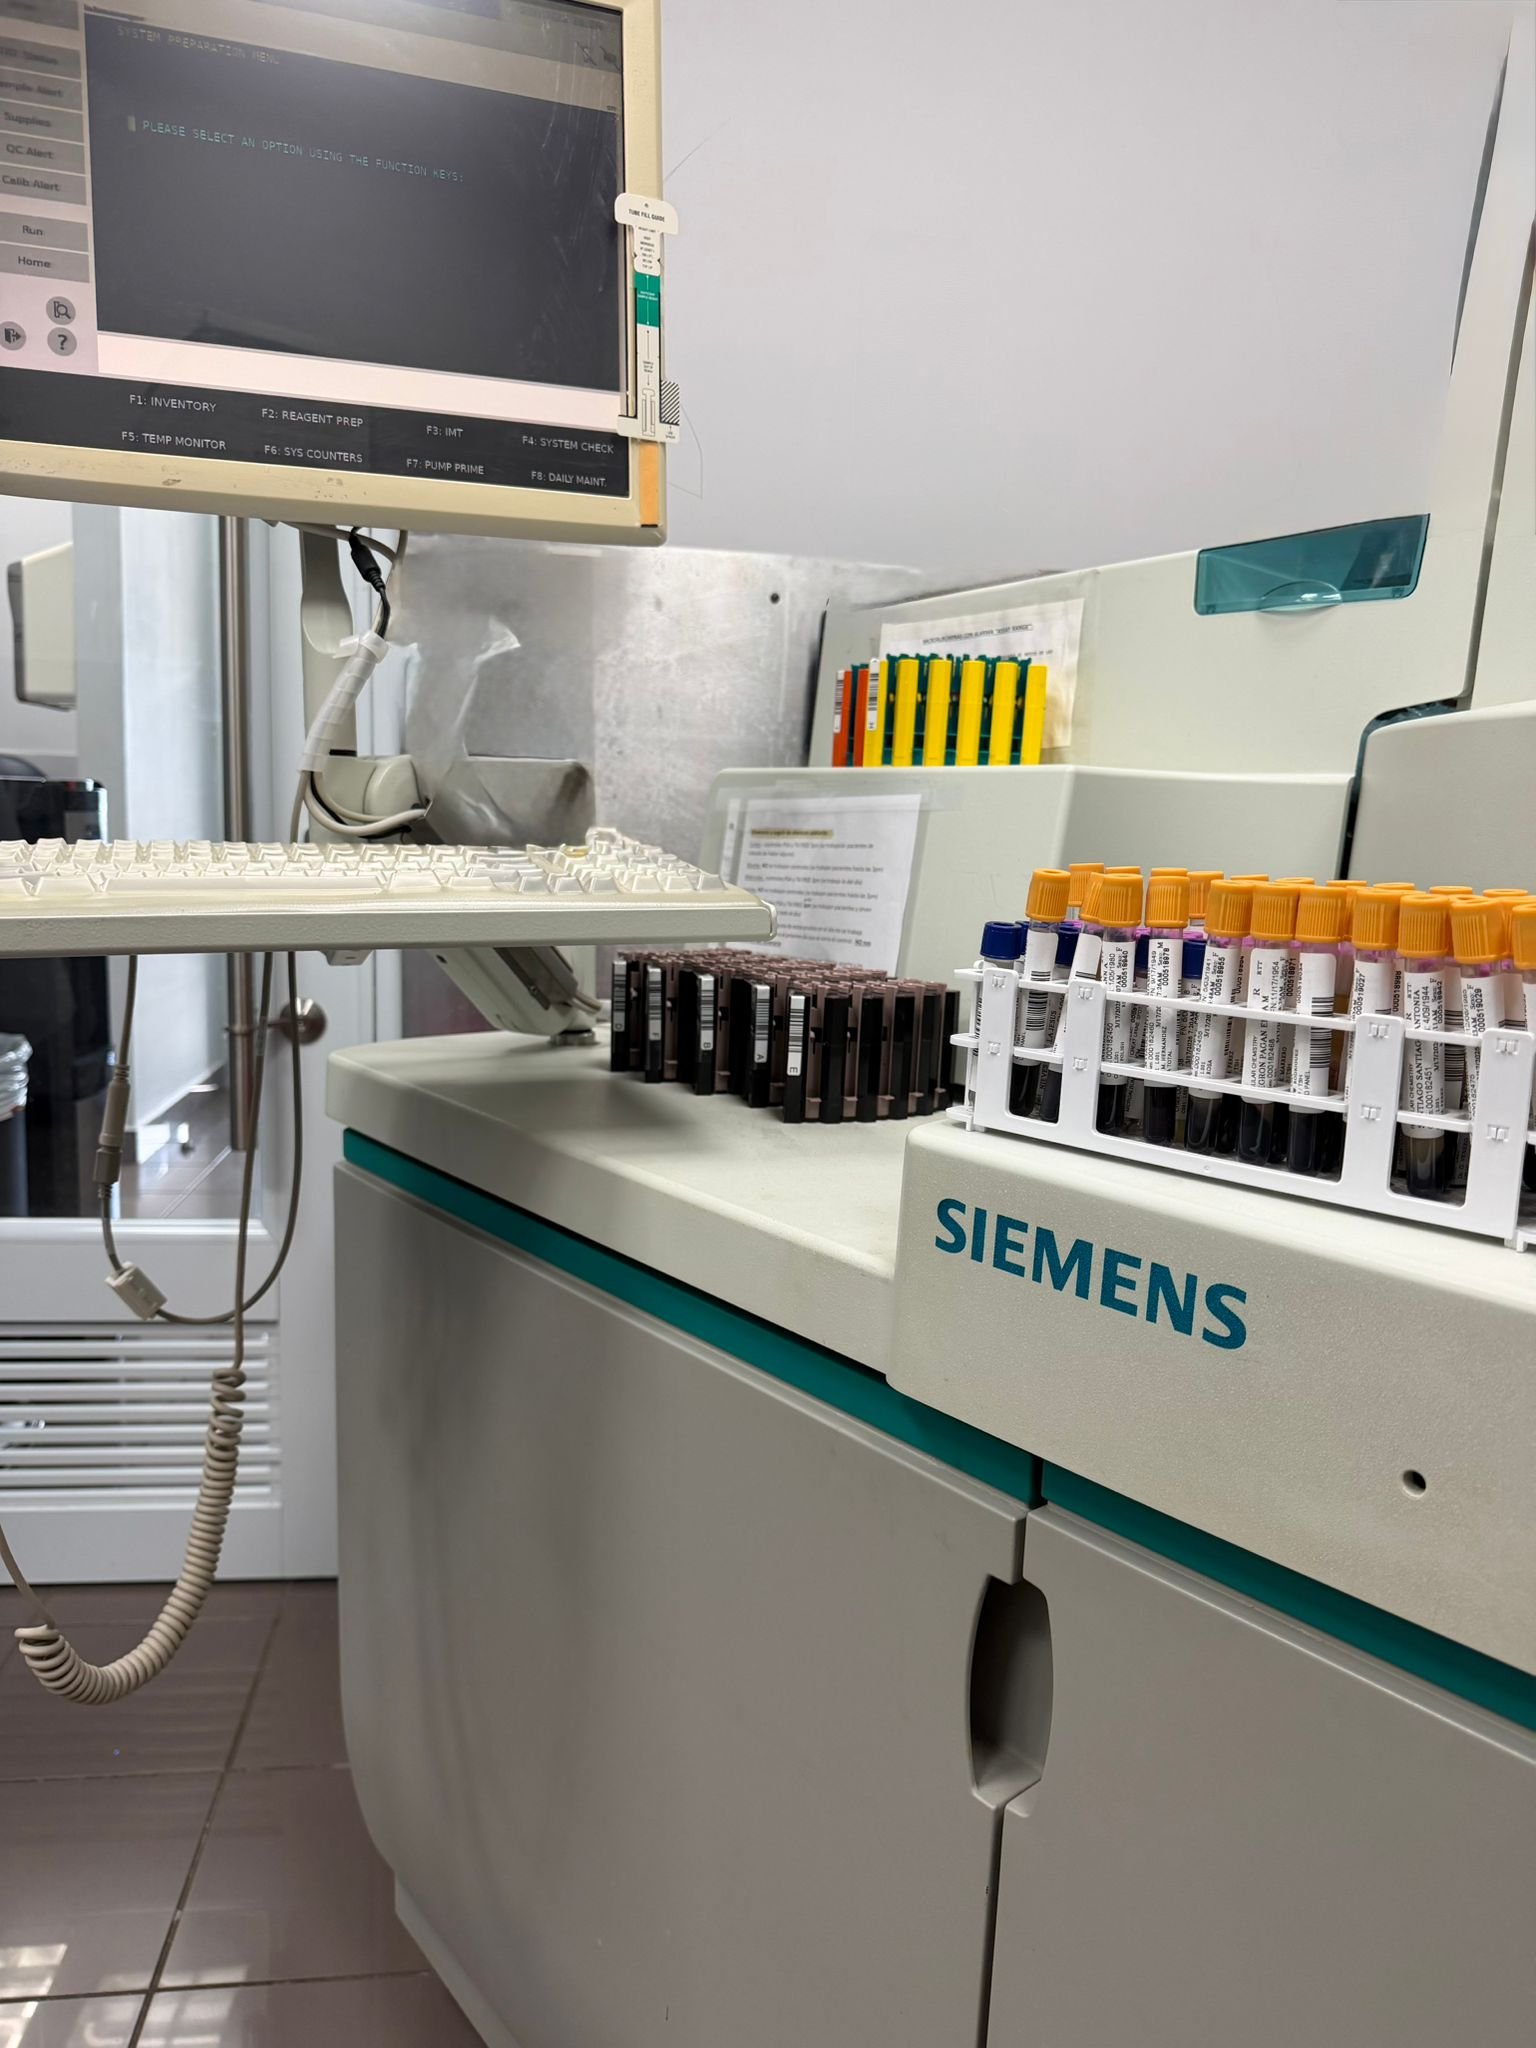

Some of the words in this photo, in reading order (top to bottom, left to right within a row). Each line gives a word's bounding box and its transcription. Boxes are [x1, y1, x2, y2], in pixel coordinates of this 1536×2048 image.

[116, 24, 161, 42] SYSTEM
[168, 33, 246, 57] PREPARATION
[4, 111, 52, 128] Supplies
[6, 143, 25, 155] QC
[26, 147, 54, 160] Alert
[143, 119, 186, 137] PLEASE
[193, 128, 235, 145] SELECT
[241, 136, 256, 148] AN
[262, 139, 303, 156] OPTION
[309, 149, 343, 162] USING
[349, 154, 369, 167] THE
[376, 158, 427, 177] FUNCTION
[433, 169, 464, 182] KEYS:
[2, 174, 30, 187] Calib
[33, 180, 61, 192] Alert
[628, 208, 640, 217] TUBE
[641, 210, 651, 219] FILL
[651, 213, 665, 223] GUIDE
[22, 224, 43, 237] Run
[18, 256, 52, 269] Home
[129, 394, 147, 406] F1:
[151, 397, 217, 413] INVENTORY
[261, 408, 278, 419] F2:
[282, 410, 333, 425] REAGENT
[336, 416, 363, 427] PREP
[121, 431, 139, 443] F5:
[142, 433, 172, 445] TEMP
[175, 436, 227, 450] MONITOR
[426, 425, 442, 436] F3:
[445, 427, 464, 438] IMT
[522, 435, 537, 446] F4:
[540, 437, 579, 451] SYSTEM
[581, 442, 615, 454] CHECK
[264, 445, 280, 456] F6:
[283, 447, 304, 458] SYS
[306, 449, 363, 463] COUNTERS
[406, 458, 422, 469] F7:
[425, 460, 452, 472] PUMP
[455, 463, 485, 475] PRIME
[531, 471, 546, 481] F8:
[548, 472, 574, 484] DAILY
[576, 475, 608, 487] MAINT.
[1157, 941, 1164, 949] M
[1214, 956, 1226, 996] 000518955
[1253, 988, 1260, 996] R
[1262, 996, 1269, 1004] M
[1355, 973, 1365, 1016] 000519027
[1421, 986, 1431, 1024] 4/09/1944
[1474, 988, 1486, 1032] 000519029
[1203, 1013, 1211, 1038] 3/17/20
[1259, 1030, 1268, 1059] PAGAN
[756, 1053, 765, 1061] A
[1414, 1040, 1423, 1081] SANTIAG
[789, 1066, 798, 1074] E
[1424, 1067, 1433, 1109] 000182451
[934, 1198, 1247, 1350] SIEMENS
